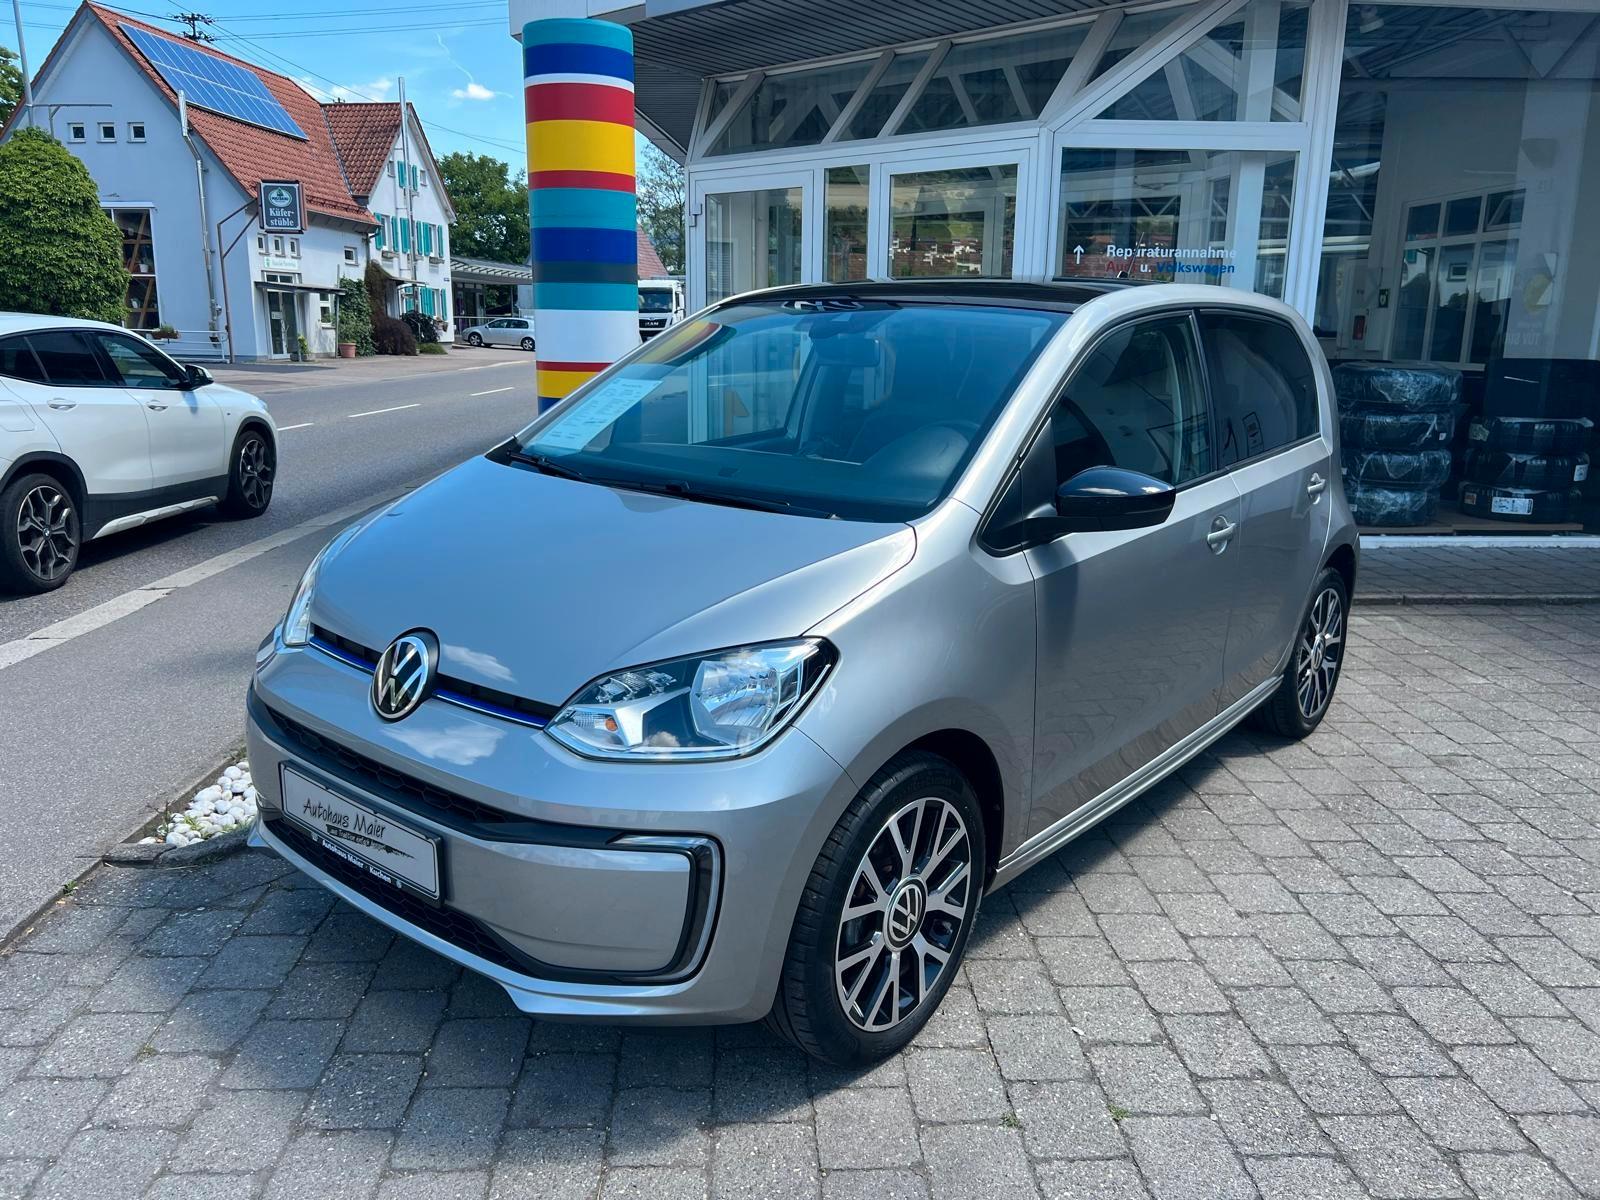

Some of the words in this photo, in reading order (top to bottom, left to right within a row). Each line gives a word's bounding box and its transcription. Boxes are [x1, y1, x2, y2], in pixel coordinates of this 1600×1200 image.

[270, 218, 294, 226] stüble
[1106, 244, 1236, 260] Reparaturannahme
[1140, 263, 1152, 273] u.
[1156, 261, 1235, 276] Volkswagen
[303, 797, 350, 828] Autohaus
[353, 813, 386, 838] Maier
[322, 839, 348, 861] Autohaus
[347, 852, 364, 869] Maier
